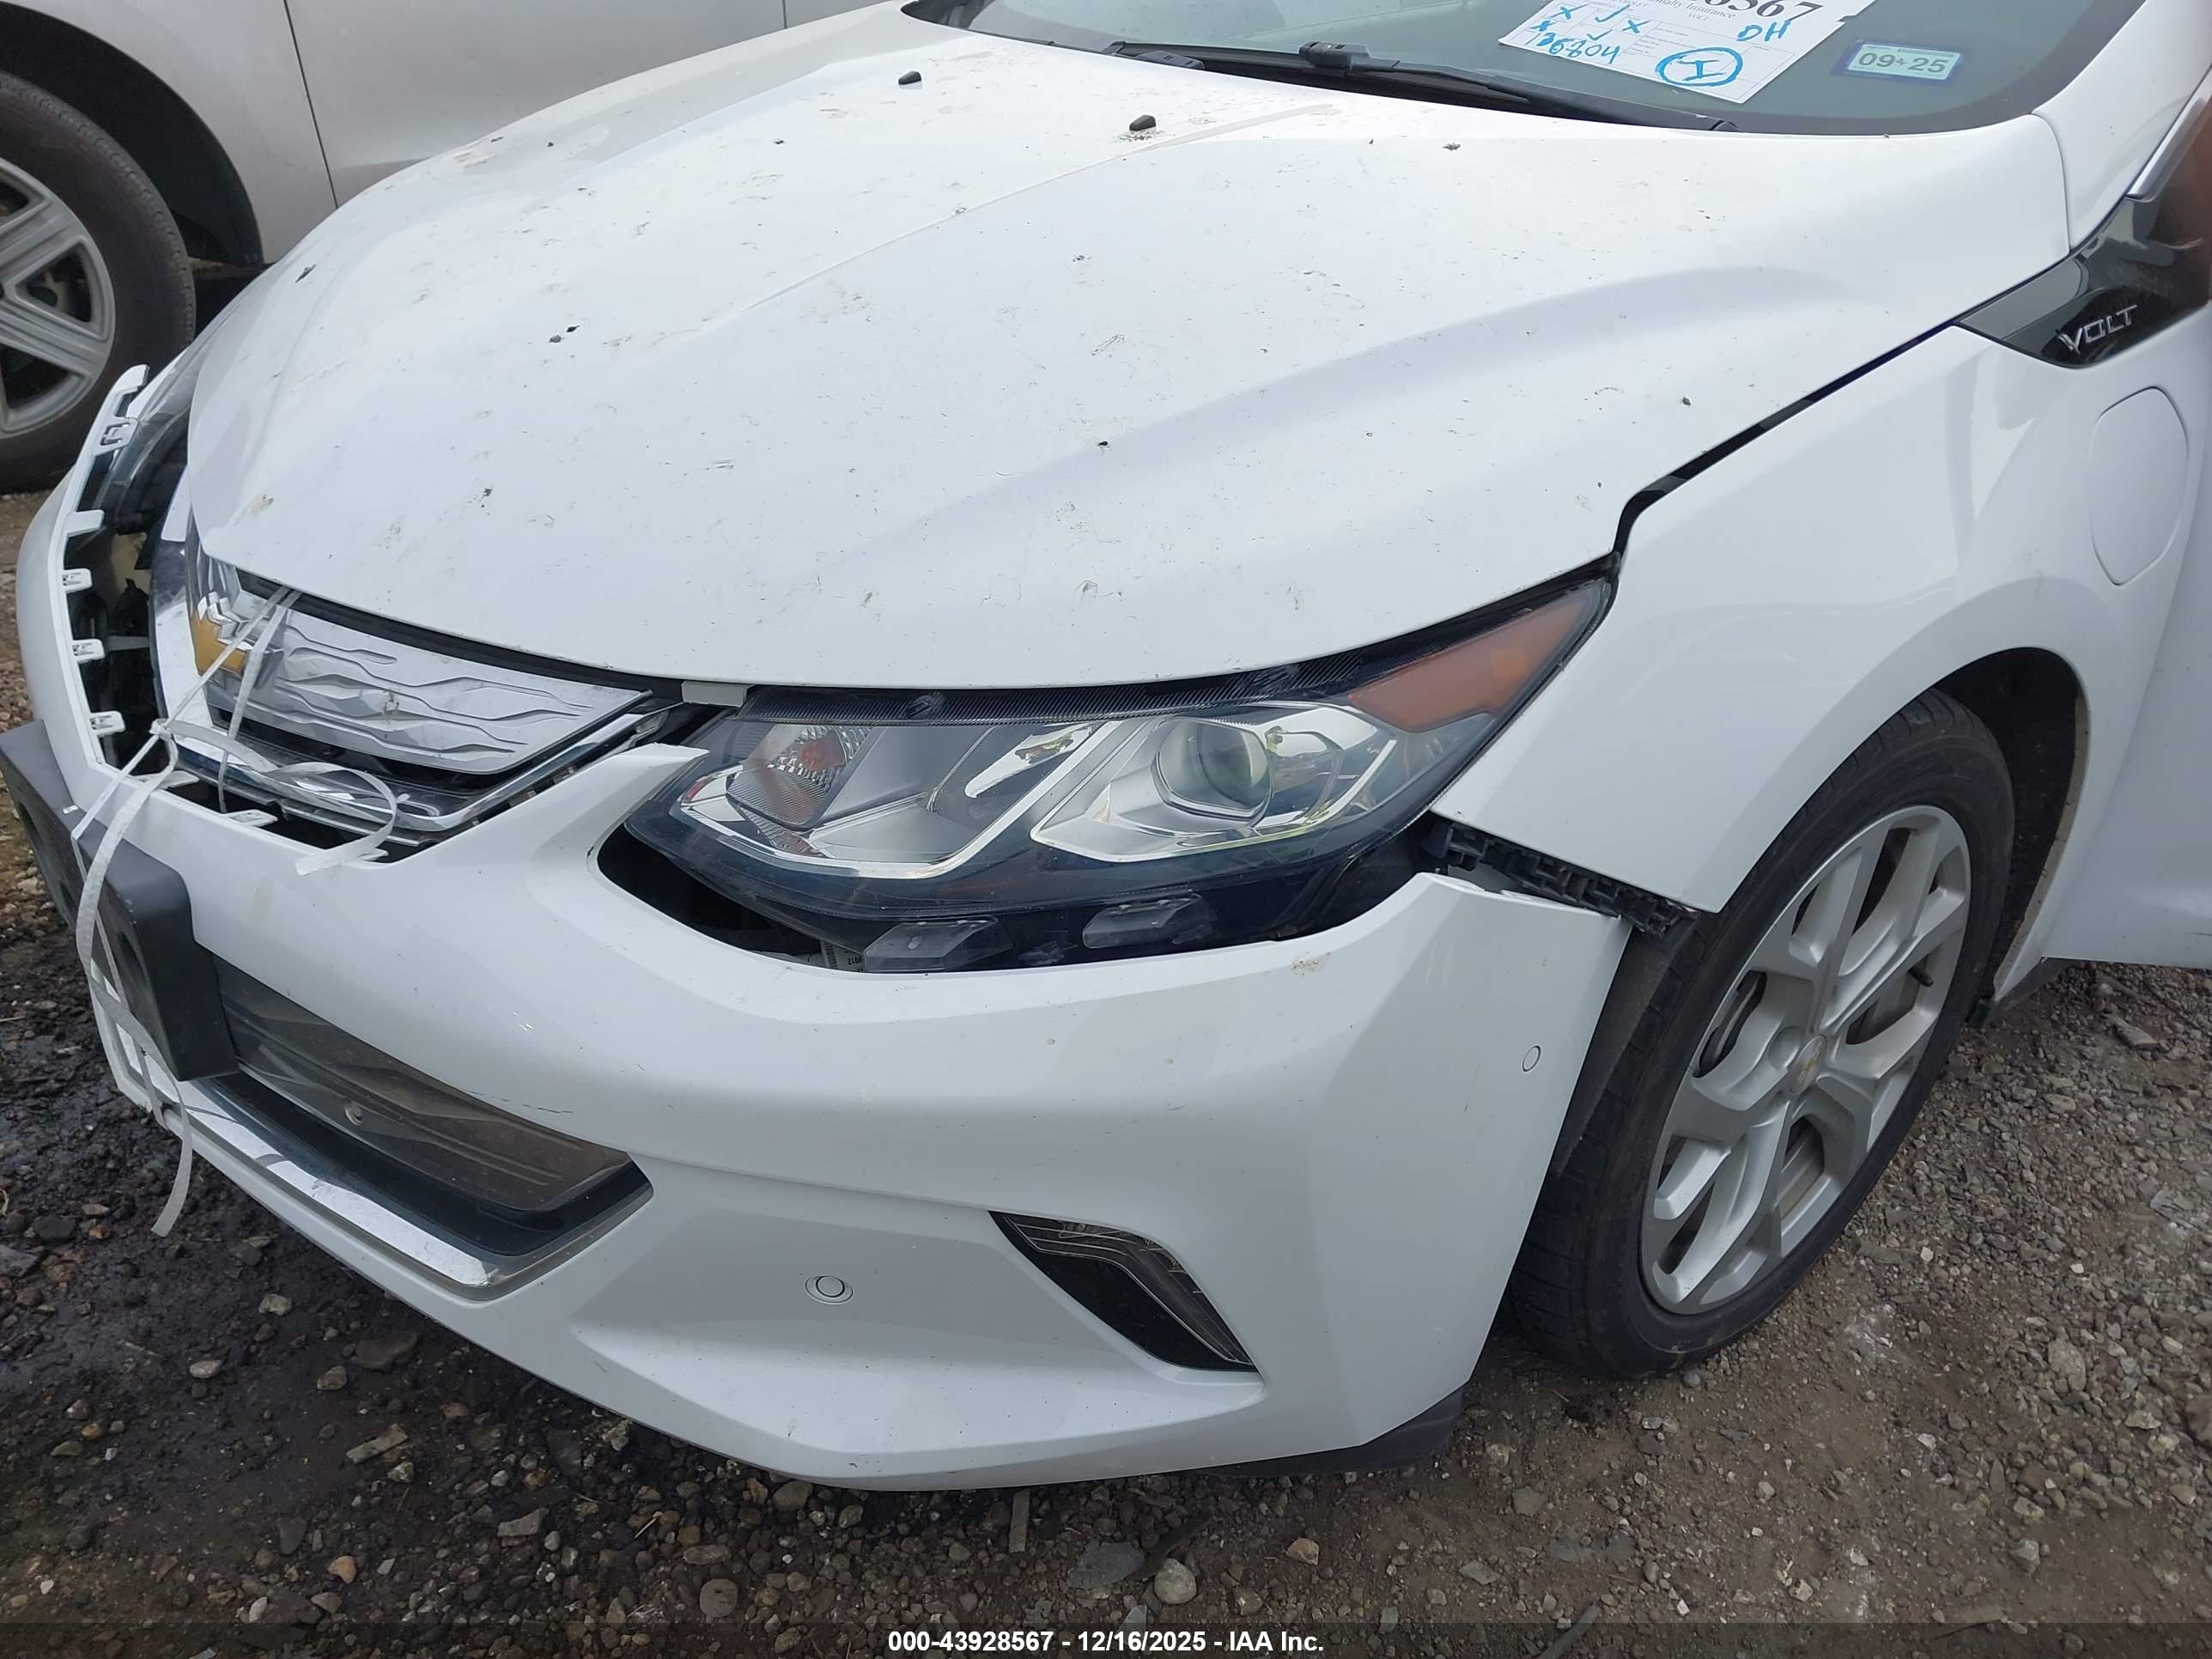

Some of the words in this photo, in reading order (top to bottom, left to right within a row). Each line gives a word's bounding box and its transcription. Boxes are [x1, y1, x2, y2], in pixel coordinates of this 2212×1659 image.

[1857, 52, 1896, 68] 09
[1906, 57, 1950, 73] 25
[2056, 303, 2138, 356] VOLT
